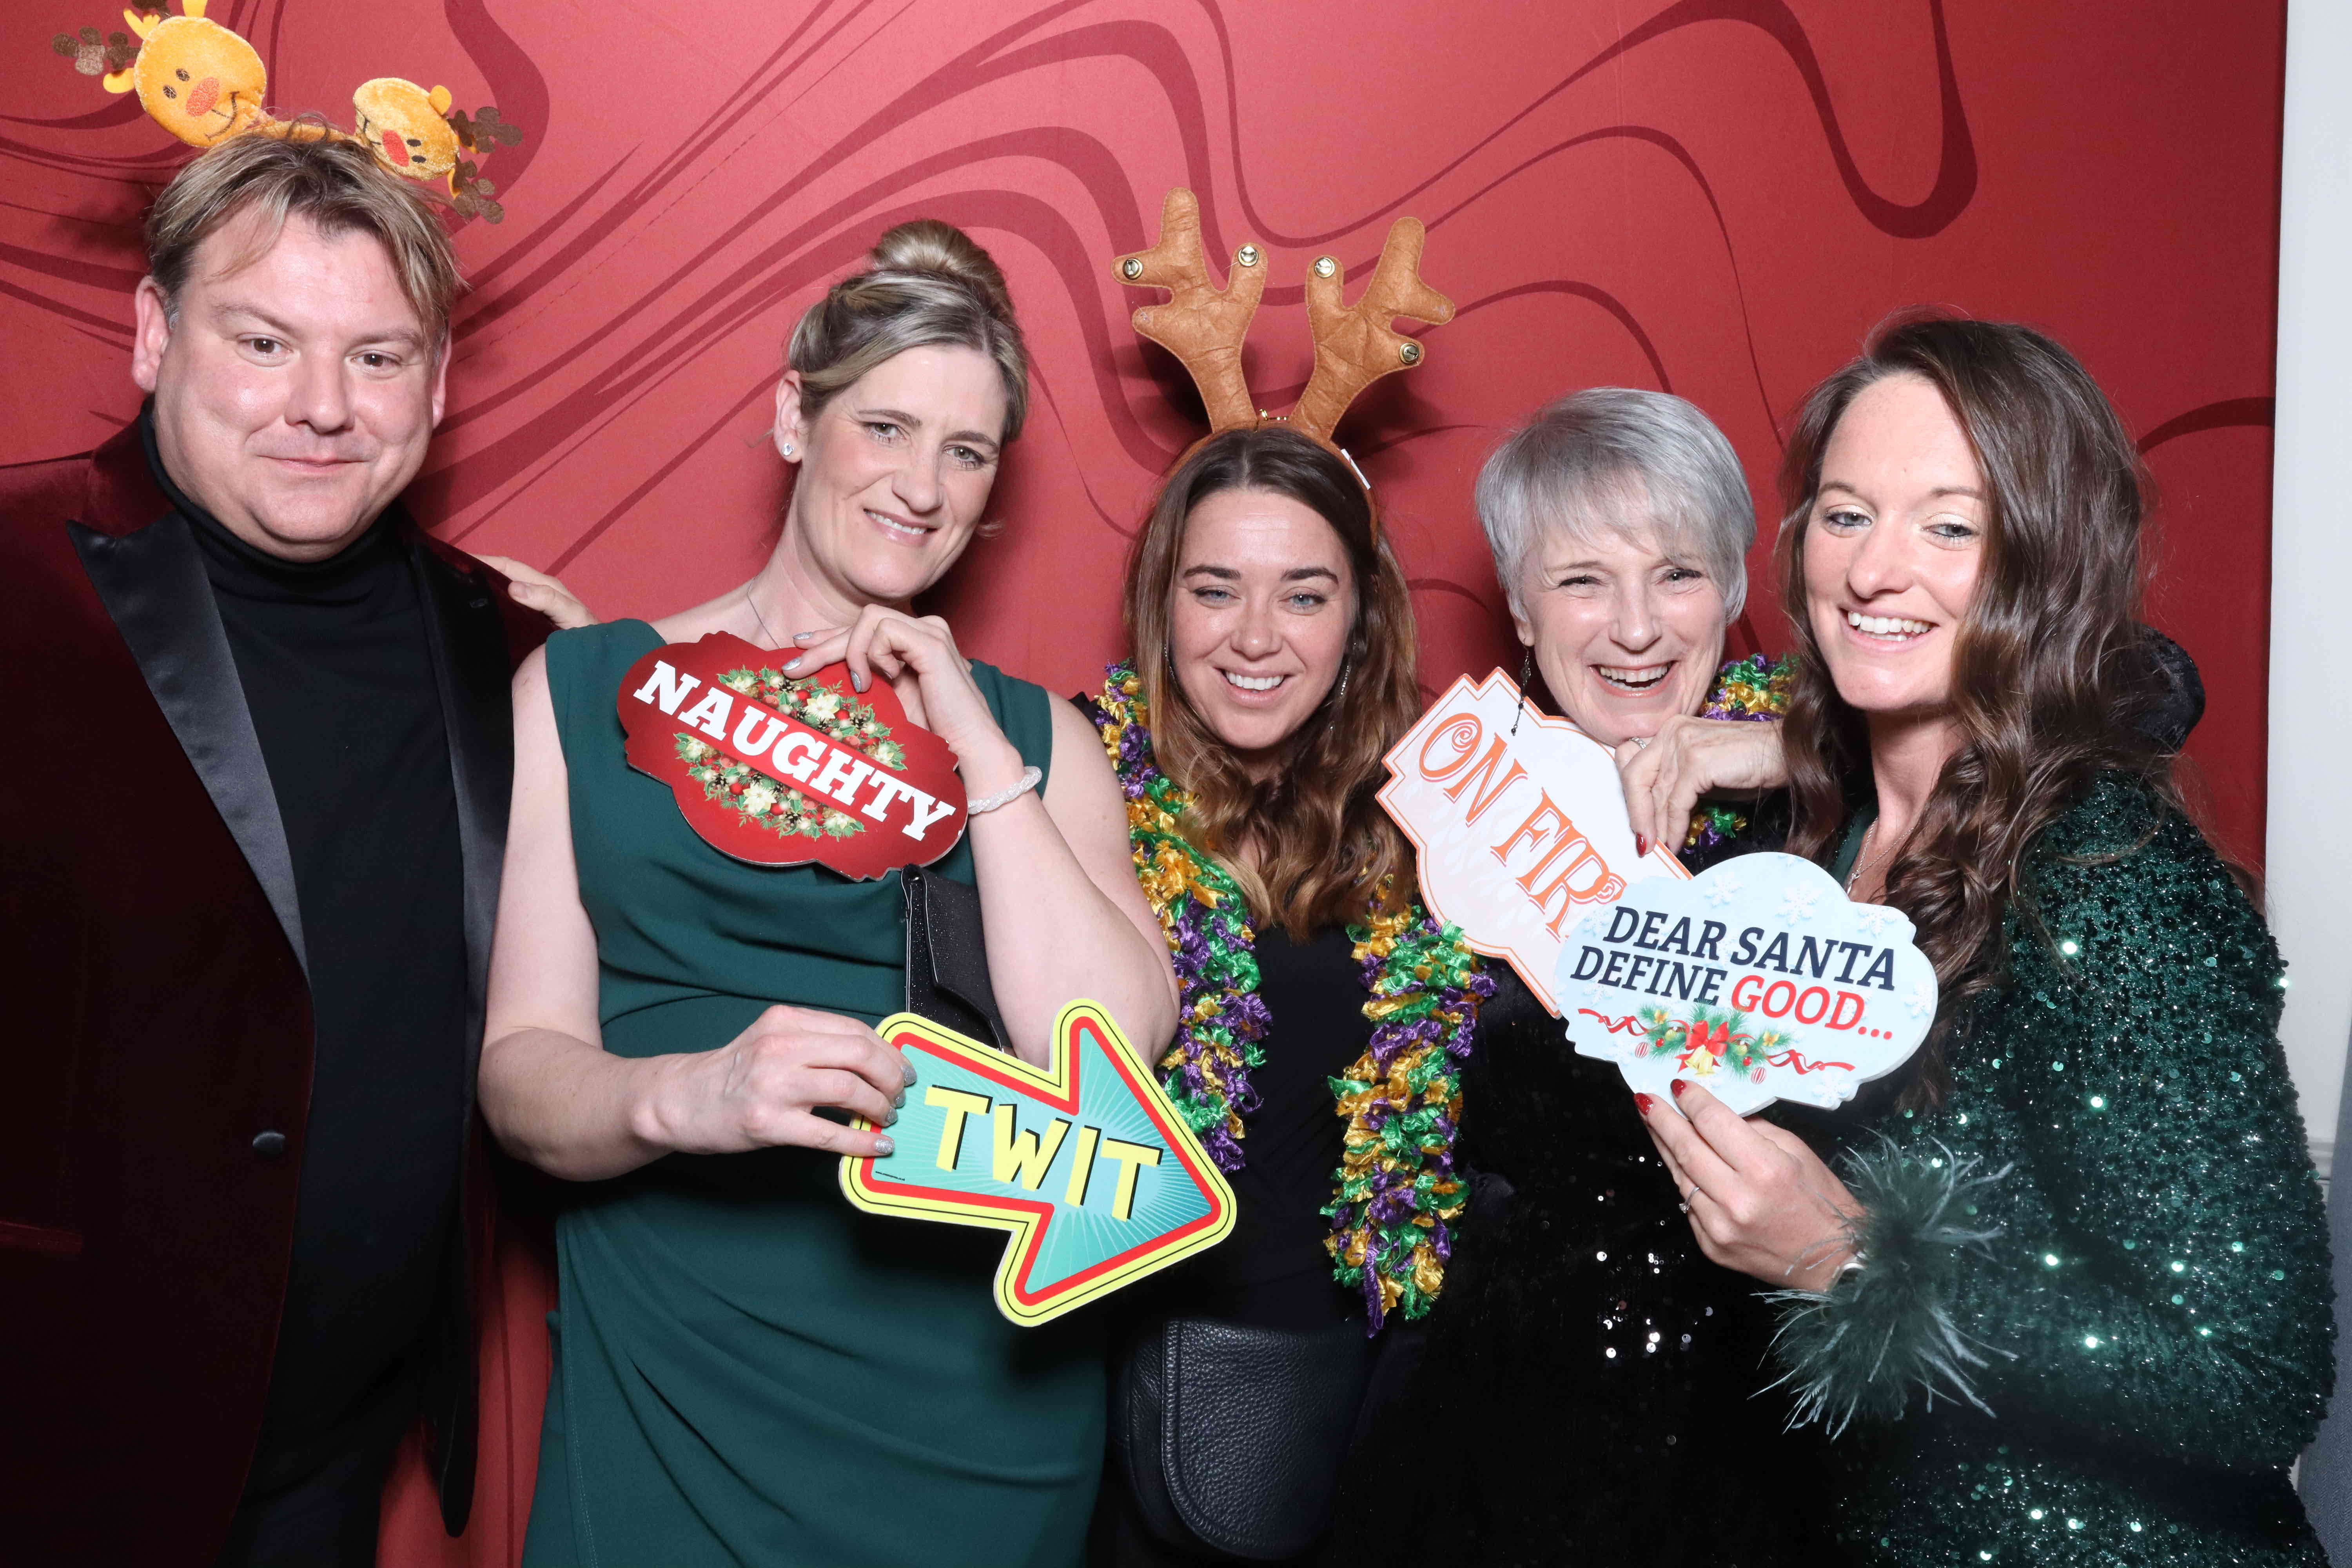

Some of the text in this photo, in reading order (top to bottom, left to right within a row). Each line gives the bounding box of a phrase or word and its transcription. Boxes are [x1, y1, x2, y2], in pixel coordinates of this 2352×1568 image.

[633, 660, 956, 841] NAUGHTY
[1419, 713, 1627, 943] ON FIR
[1570, 946, 1893, 1040] DEFINE GOOD...
[1603, 906, 1895, 991] DEAR SANTA
[924, 1085, 1163, 1222] TWIT
